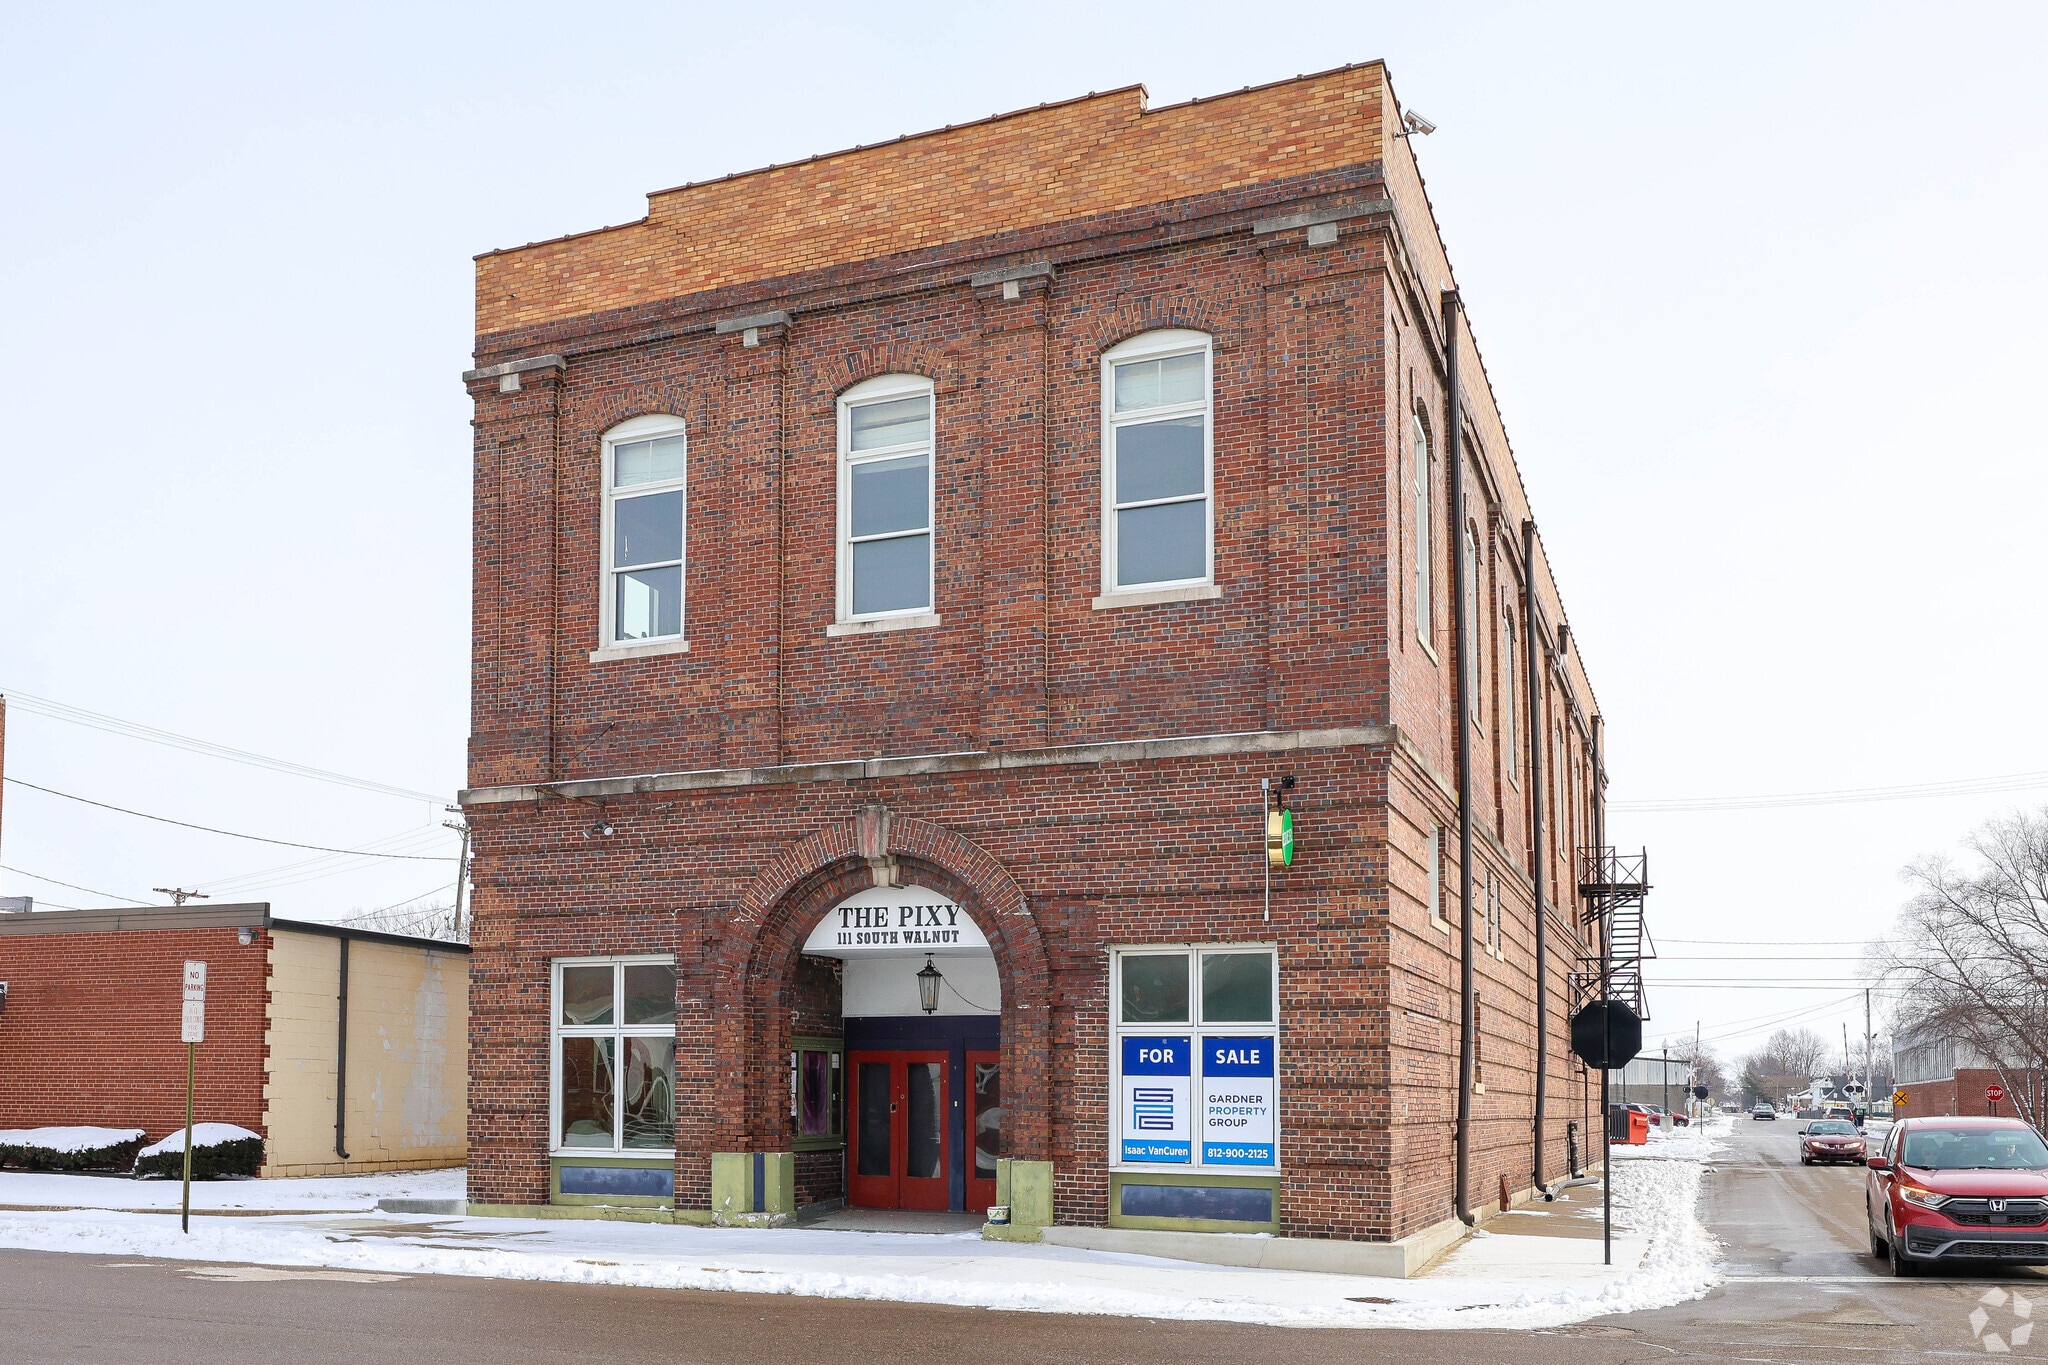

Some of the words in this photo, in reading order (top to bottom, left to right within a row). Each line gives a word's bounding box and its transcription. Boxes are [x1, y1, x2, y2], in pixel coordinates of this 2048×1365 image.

[838, 906, 889, 928] THE
[898, 904, 960, 927] PIXY
[837, 932, 852, 945] 111
[857, 931, 898, 945] SOUTH
[903, 930, 960, 943] WALNUT
[185, 983, 204, 992] PARKING
[1139, 1048, 1174, 1063] FOR
[1215, 1049, 1260, 1064] SALE
[1208, 1094, 1263, 1104] GARDNER
[1208, 1106, 1267, 1116] PROPERTY
[1208, 1118, 1248, 1127] GROUP
[1125, 1145, 1146, 1155] Isaac
[1148, 1146, 1188, 1156] VanCuren
[1207, 1148, 1268, 1159] 812-900-2125
